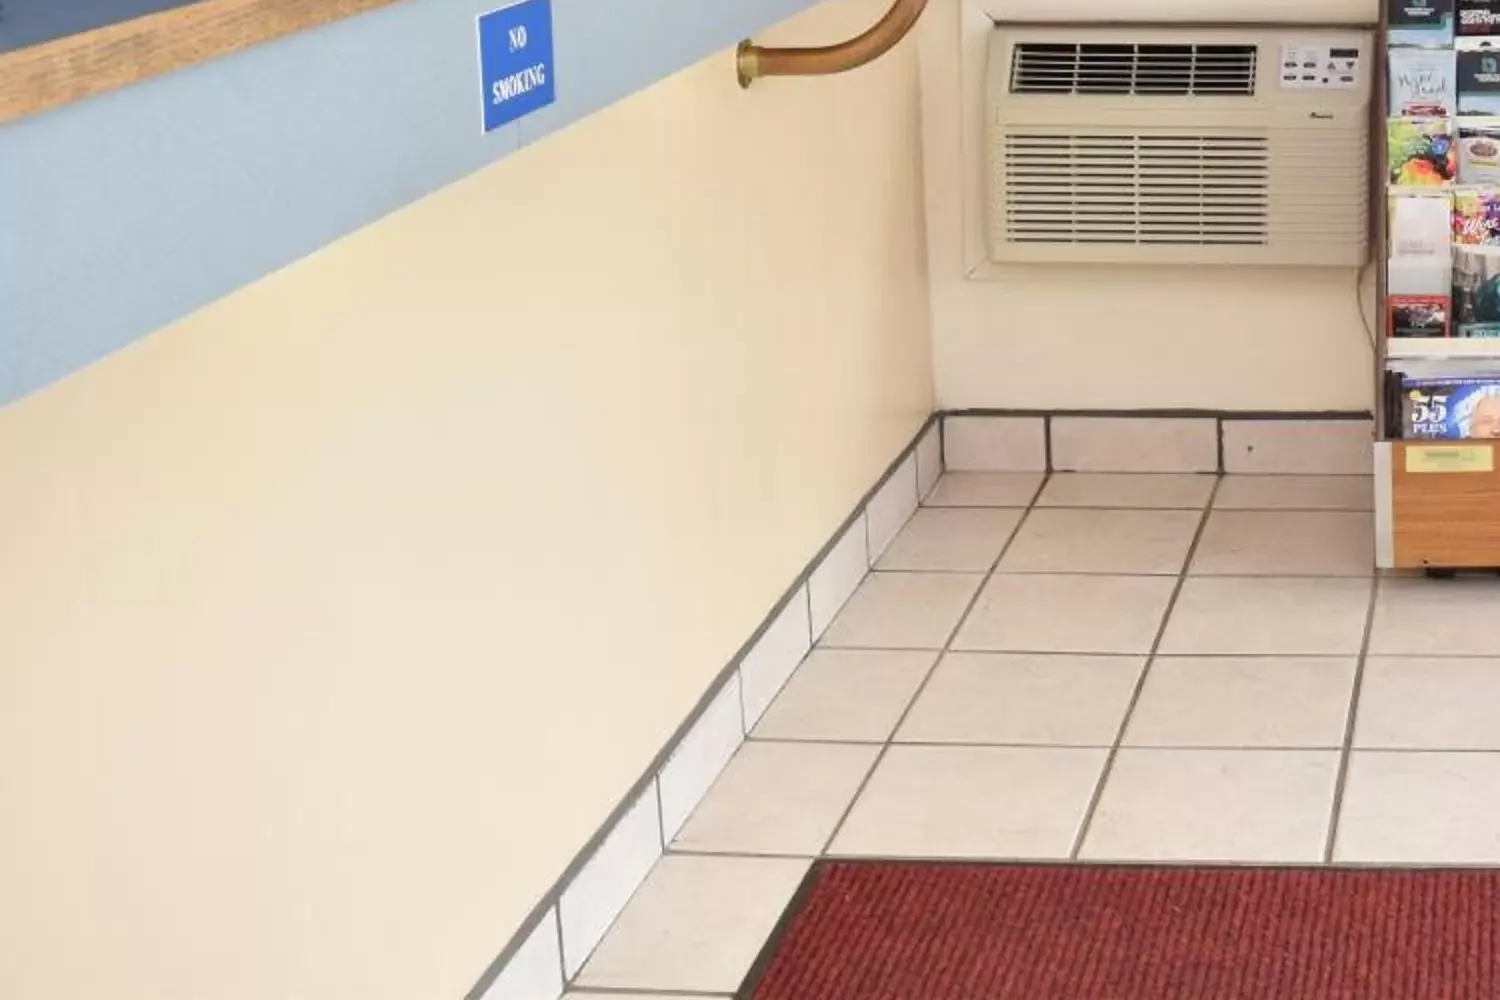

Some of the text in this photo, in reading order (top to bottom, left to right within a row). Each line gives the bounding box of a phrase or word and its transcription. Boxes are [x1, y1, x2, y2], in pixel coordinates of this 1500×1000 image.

[508, 24, 528, 54] NO
[492, 61, 545, 105] SMOKING
[1411, 394, 1448, 423] 55
[1412, 423, 1448, 434] PLUS
